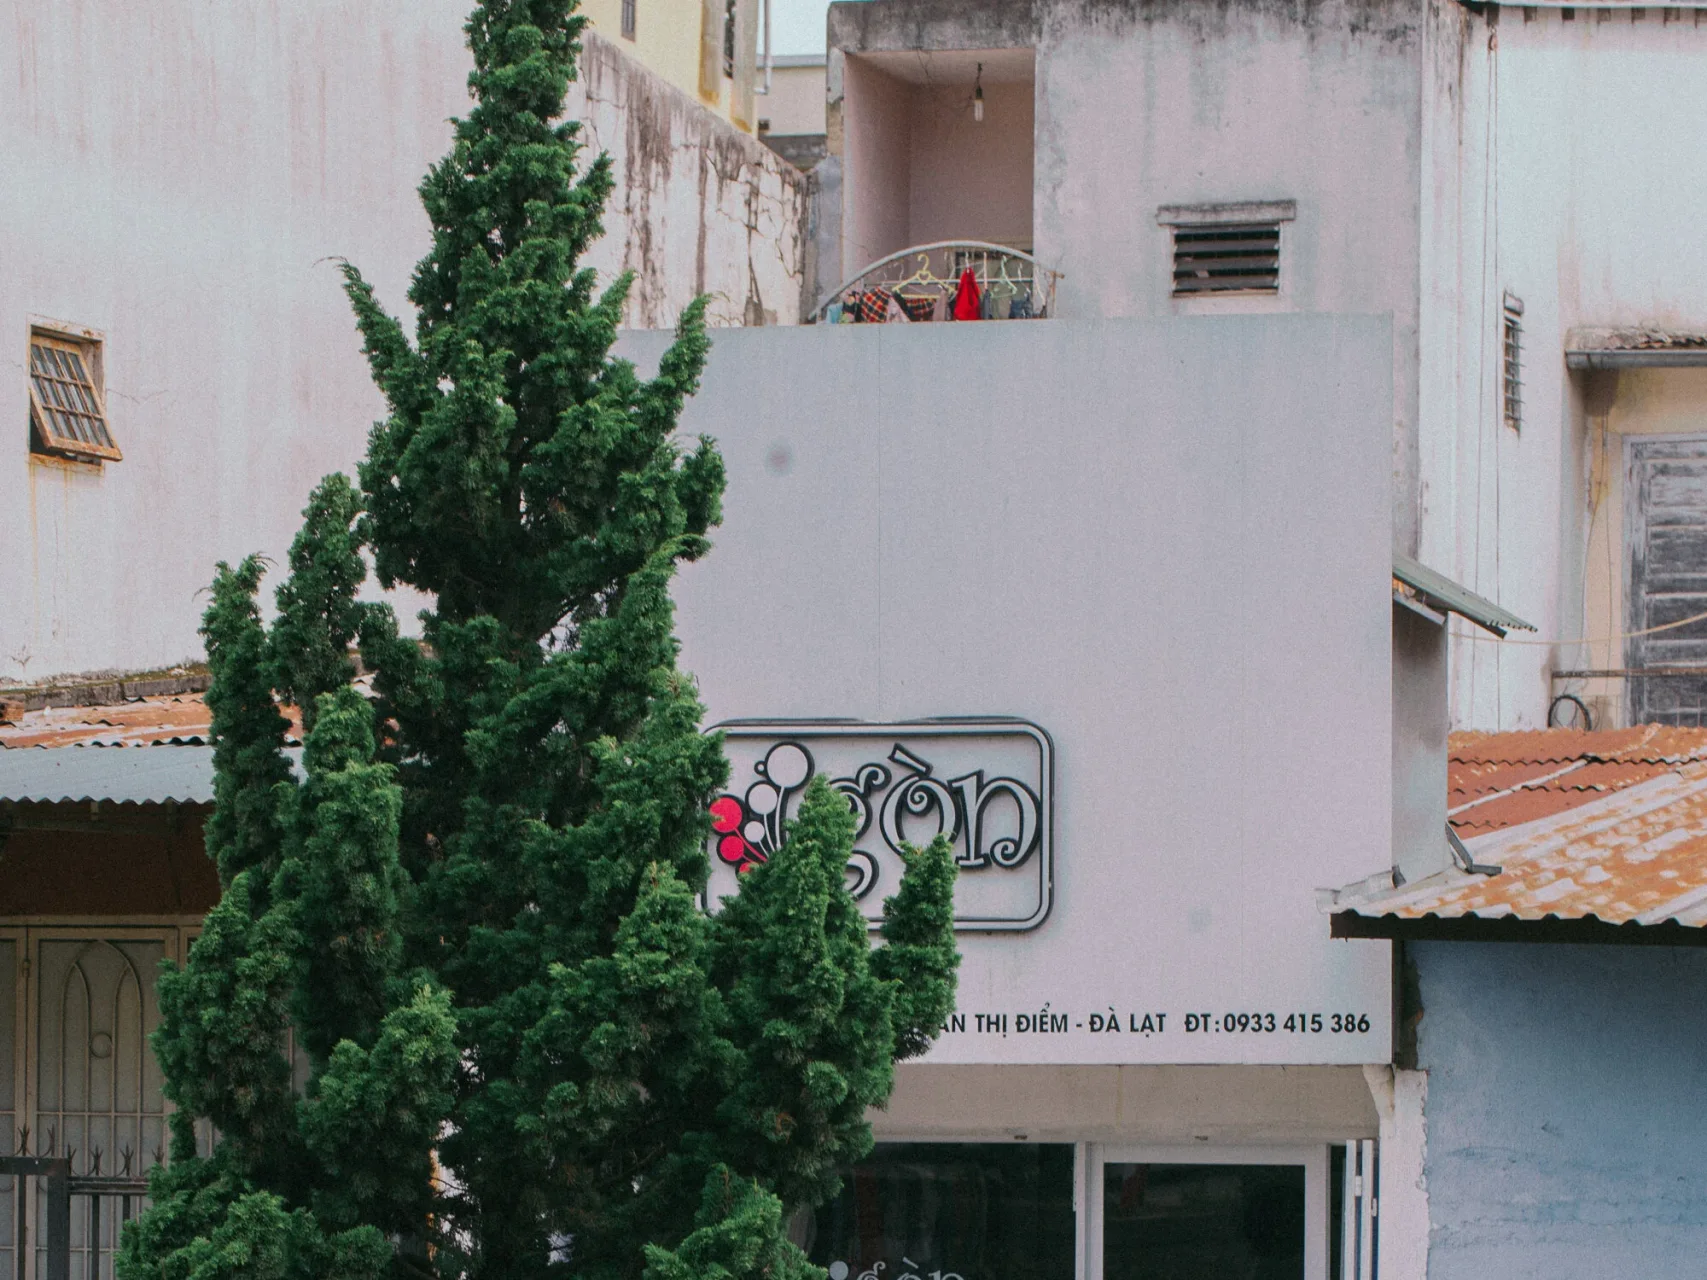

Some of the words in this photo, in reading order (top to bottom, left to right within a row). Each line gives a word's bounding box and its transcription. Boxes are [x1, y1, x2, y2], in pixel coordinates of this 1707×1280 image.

[974, 1013, 1007, 1038] THỊ
[1015, 1002, 1068, 1033] ĐIỂM
[1088, 1006, 1121, 1033] ĐÀ
[1129, 1013, 1167, 1038] LẠT
[1283, 1013, 1323, 1034] 415
[1330, 1013, 1371, 1034] 386
